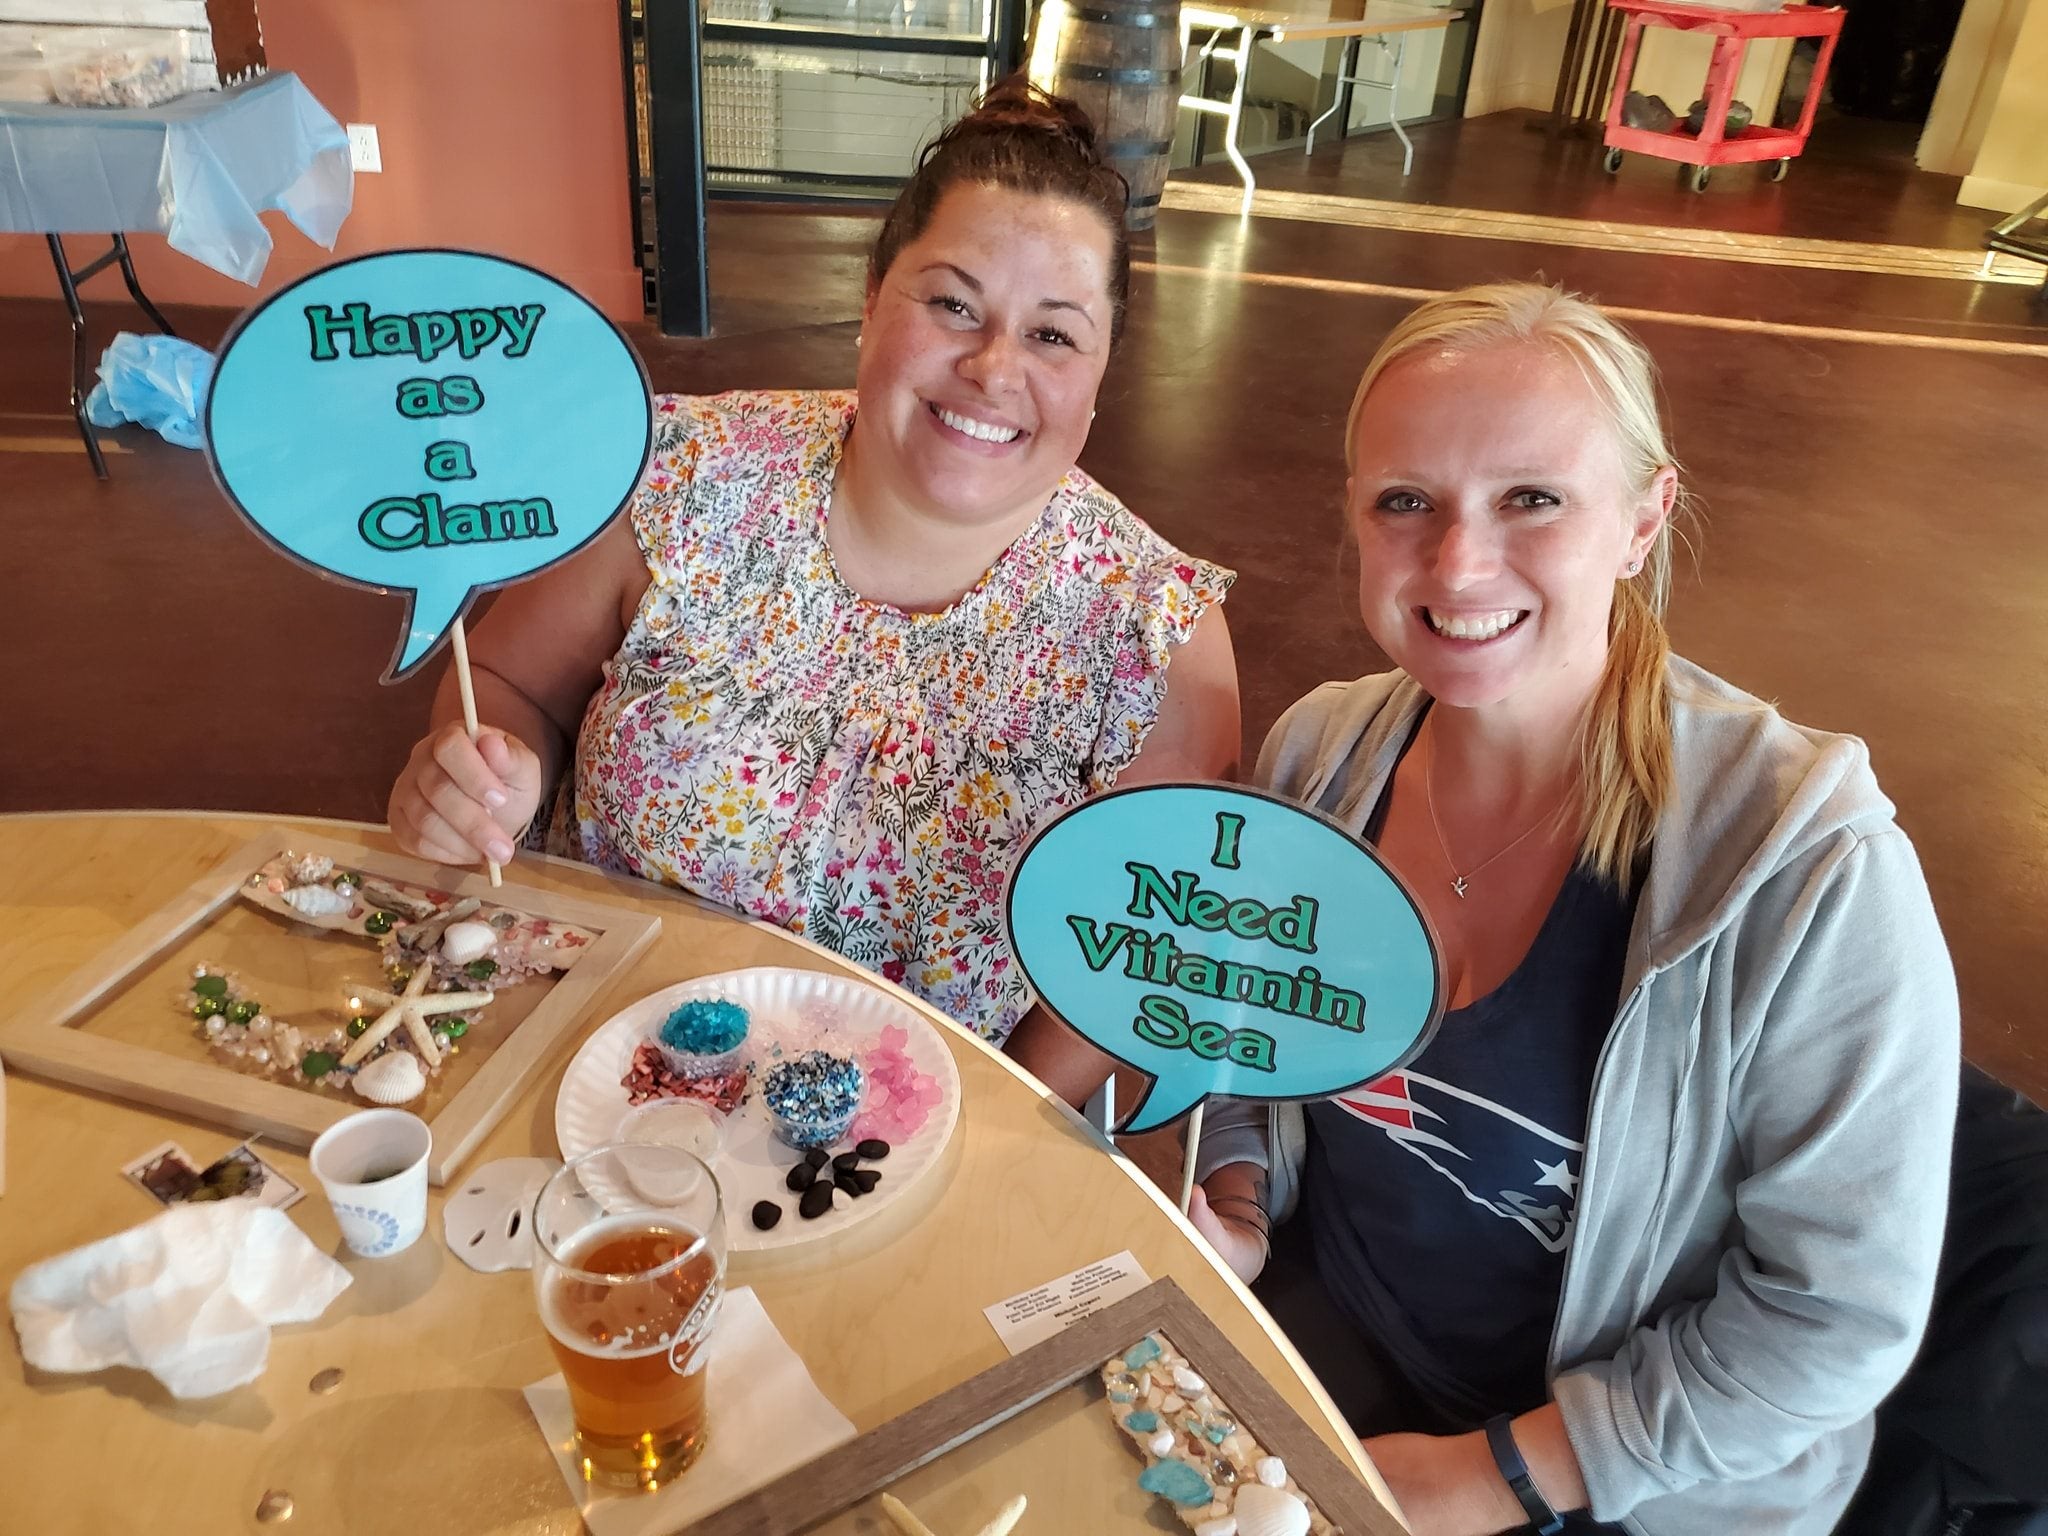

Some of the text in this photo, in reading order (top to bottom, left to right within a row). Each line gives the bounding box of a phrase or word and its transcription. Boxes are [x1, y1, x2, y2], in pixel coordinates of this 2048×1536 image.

[304, 303, 546, 362] Happy
[396, 376, 485, 418] as
[425, 440, 477, 481] a
[358, 493, 558, 551] Clam
[1211, 812, 1246, 869] I
[1125, 862, 1319, 954] Need
[1066, 915, 1366, 1033] Vitamin
[1133, 995, 1277, 1073] Sea
